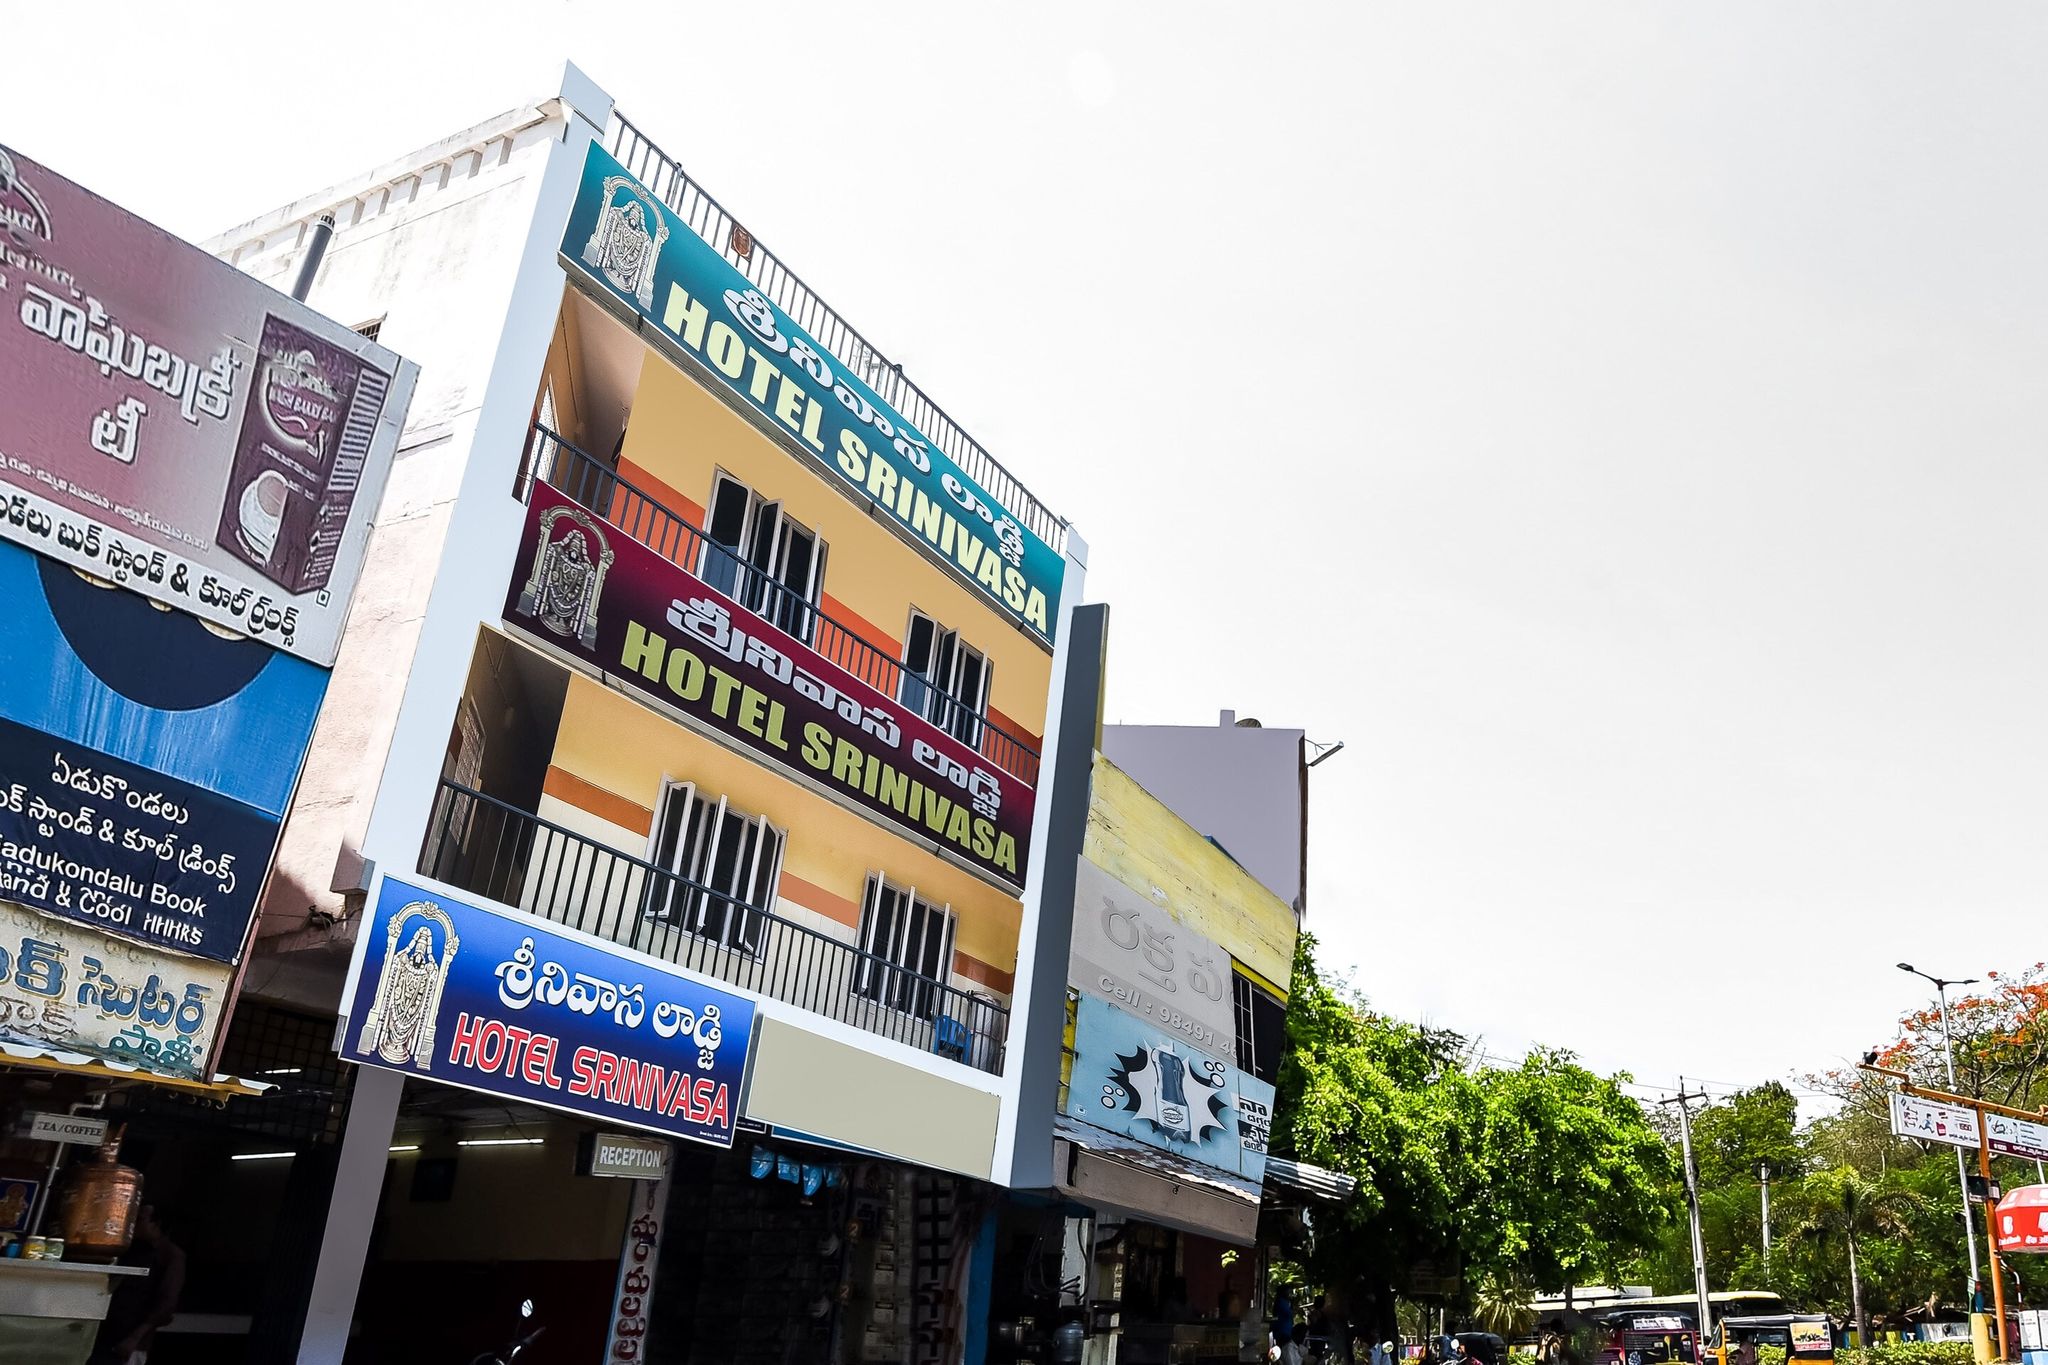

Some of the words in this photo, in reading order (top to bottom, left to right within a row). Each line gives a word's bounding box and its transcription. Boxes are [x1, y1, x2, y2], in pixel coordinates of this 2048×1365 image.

[724, 287, 932, 474] శ్రీనివాస
[662, 281, 826, 454] HOTEL
[837, 428, 1048, 634] SRINIVASA
[57, 521, 103, 559] బుక్
[170, 562, 190, 597] &
[666, 597, 901, 749] శ్రీనివాస
[619, 620, 789, 752] HOTEL
[801, 721, 1017, 875] SRINIVASA
[0, 835, 144, 899] adukondalu
[151, 882, 207, 918] Book
[98, 818, 115, 845] &
[55, 880, 71, 907] &
[80, 890, 132, 925] Cool
[494, 936, 646, 1029] శ్రీనివాస
[652, 1000, 723, 1071] లాడ్జి
[1158, 1005, 1215, 1047] 98491
[449, 1011, 563, 1091] HOTEL
[568, 1045, 729, 1130] SRINIVASA
[599, 1145, 662, 1169] RECEPTION
